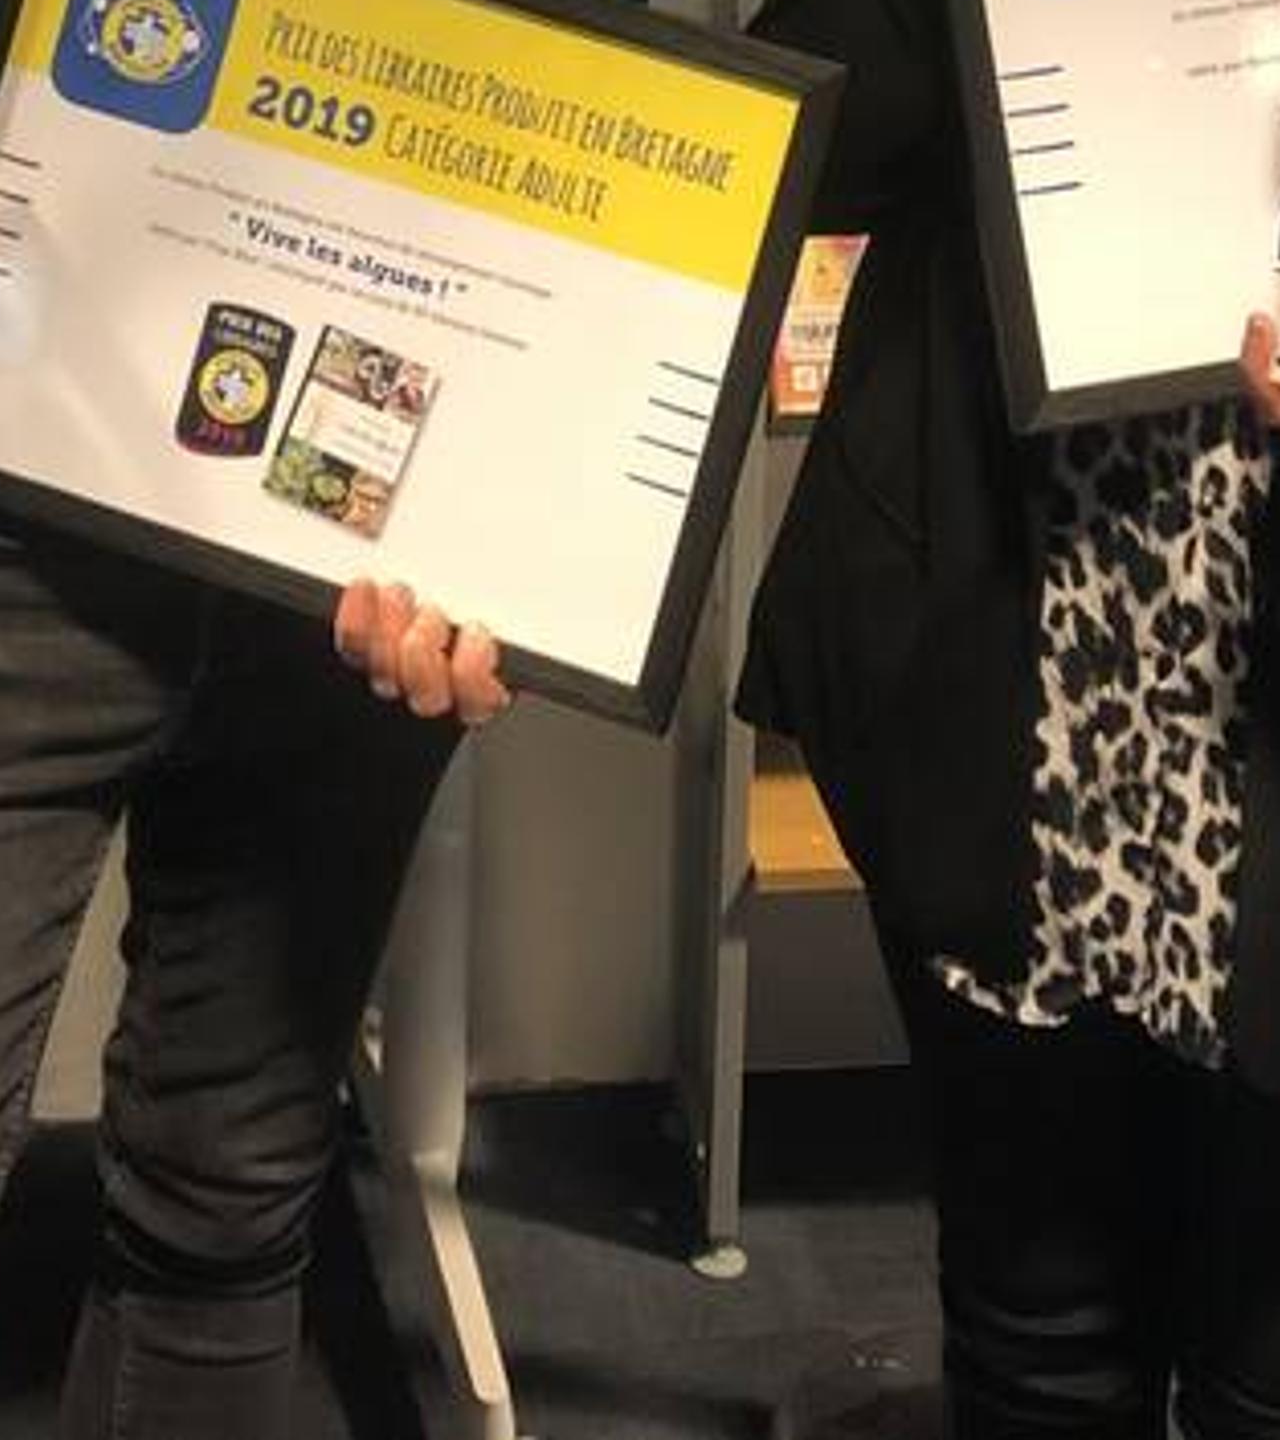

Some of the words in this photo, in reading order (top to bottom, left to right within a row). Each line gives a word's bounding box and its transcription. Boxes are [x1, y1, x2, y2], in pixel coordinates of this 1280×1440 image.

[248, 74, 376, 147] 2019
[361, 38, 477, 113] LIBRAIRES
[246, 216, 303, 256] Vive
[306, 236, 343, 267] les
[347, 255, 434, 296] algues
